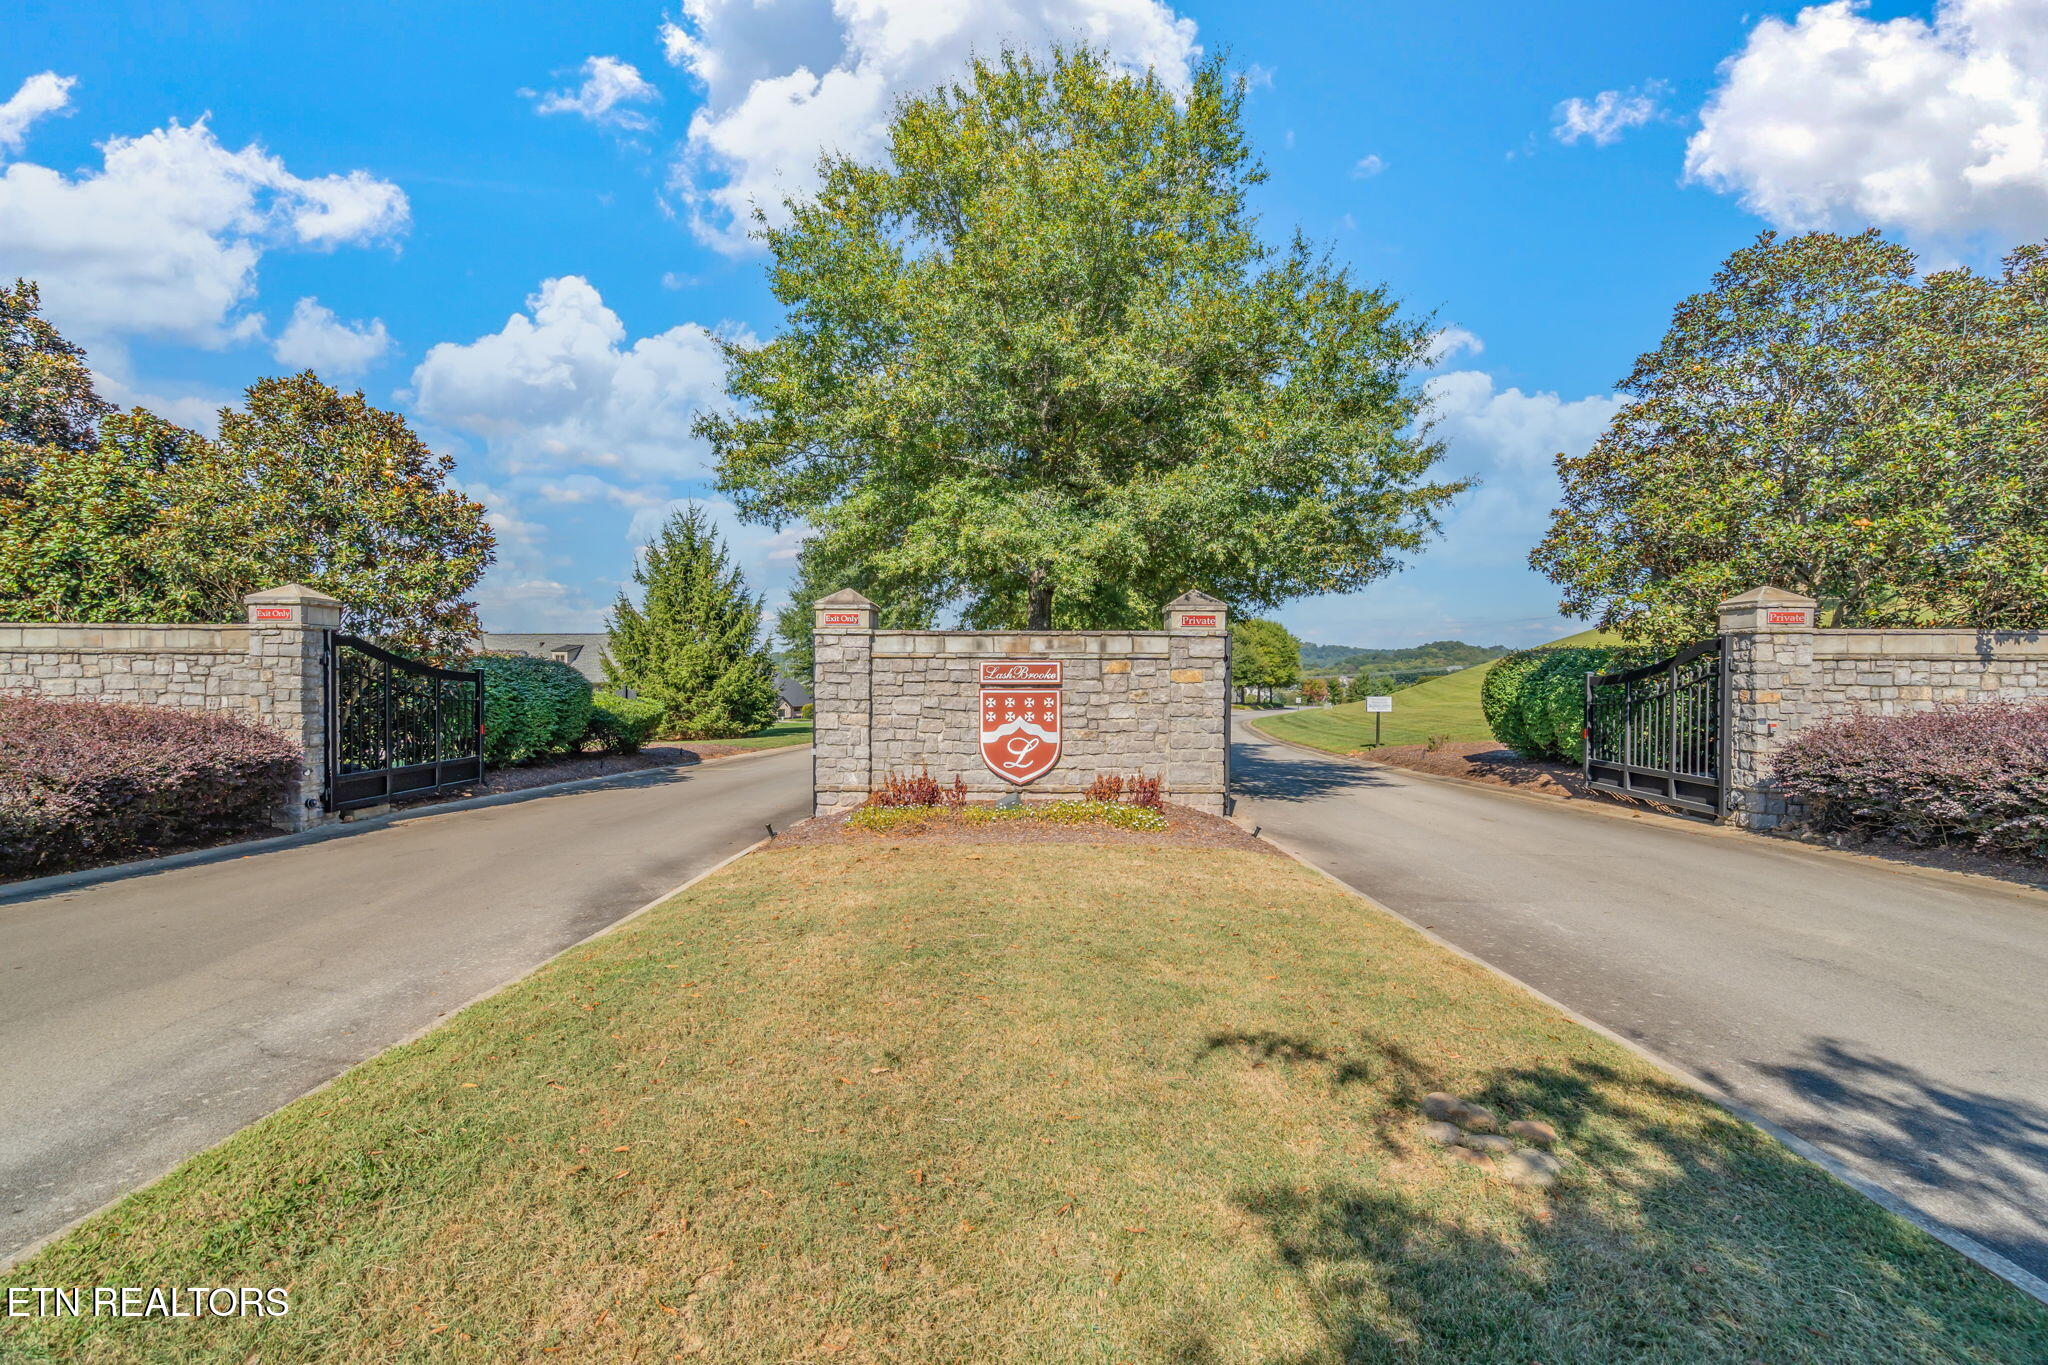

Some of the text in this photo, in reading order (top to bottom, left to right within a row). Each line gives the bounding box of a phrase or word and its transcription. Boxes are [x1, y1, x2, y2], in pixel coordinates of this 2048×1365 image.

[273, 610, 290, 619] Only
[1770, 613, 1805, 622] Private
[841, 615, 859, 625] Only
[1183, 616, 1216, 625] Private
[1003, 737, 1039, 768] L
